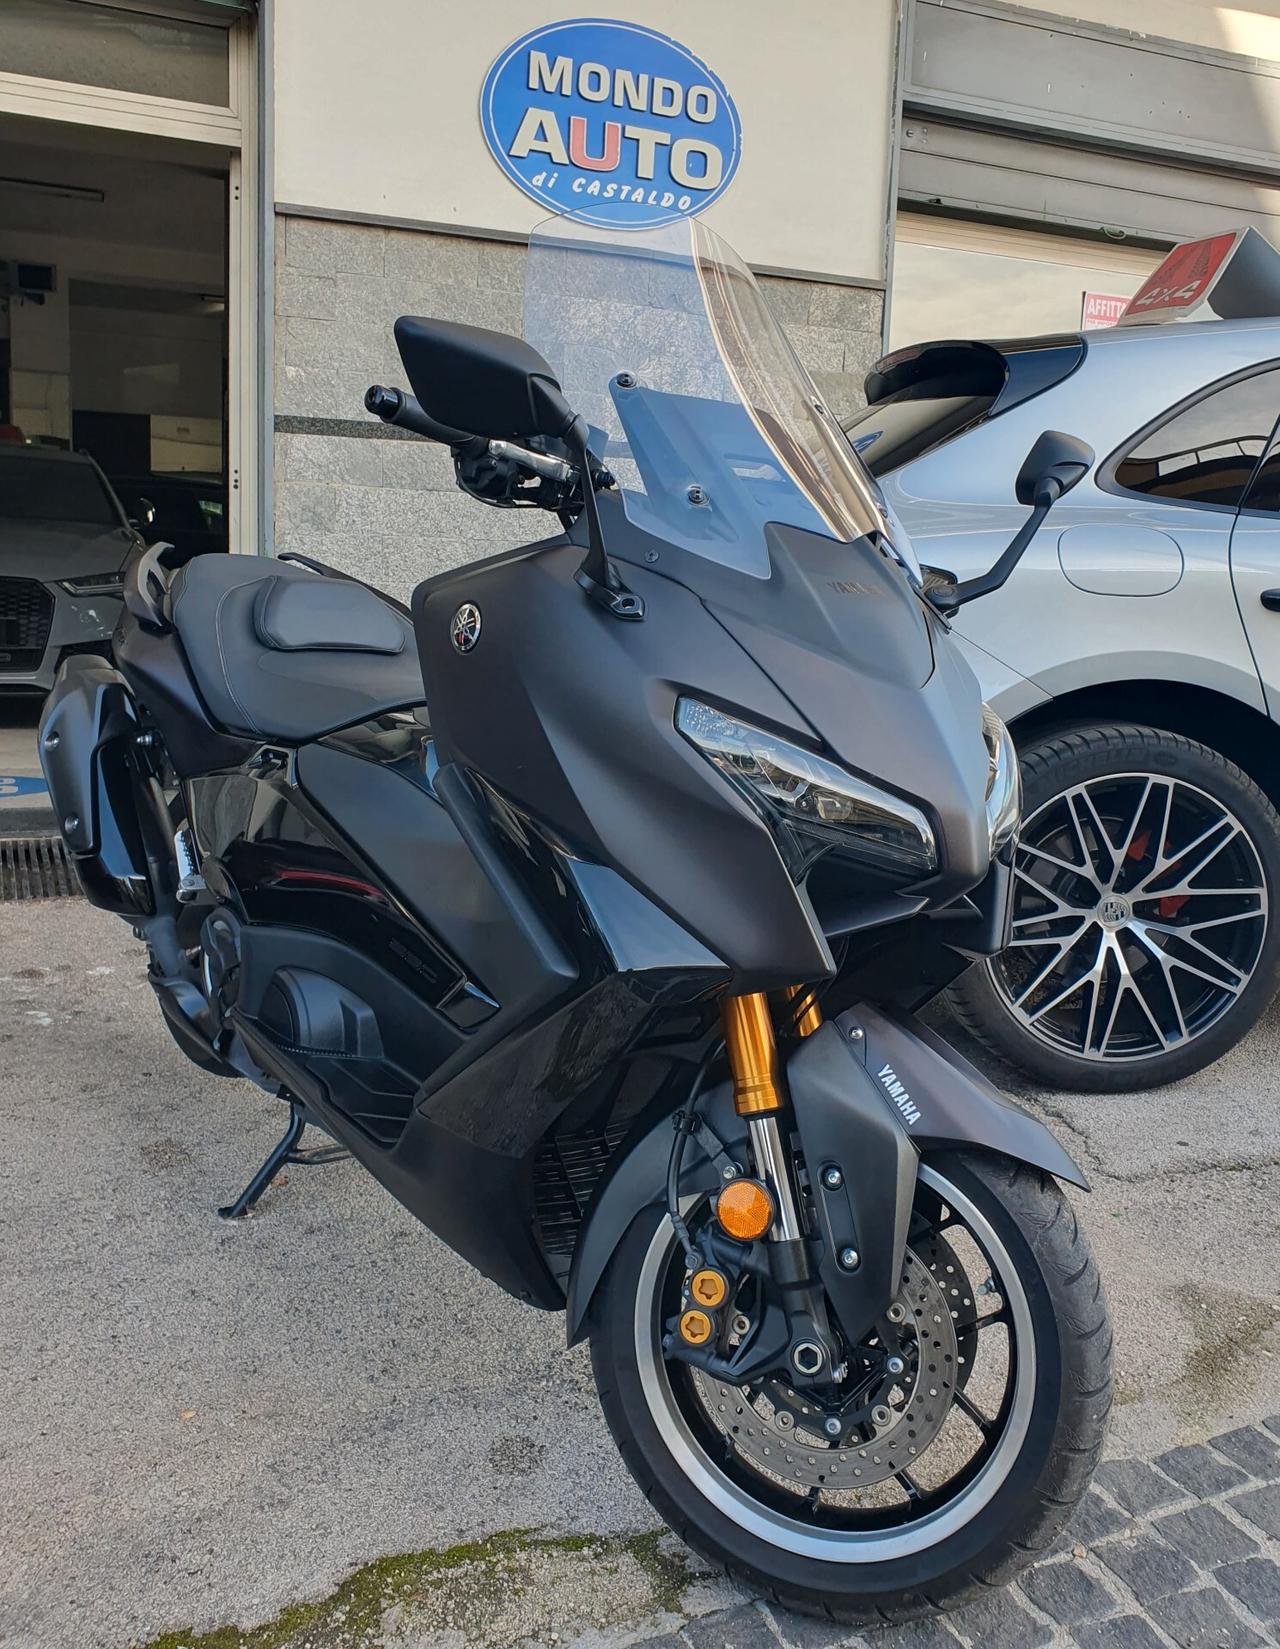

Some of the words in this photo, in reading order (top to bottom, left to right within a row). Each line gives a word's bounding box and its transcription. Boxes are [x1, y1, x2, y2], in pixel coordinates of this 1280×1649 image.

[528, 50, 717, 124] MONDO
[508, 107, 723, 190] AUTO
[531, 171, 559, 189] di
[572, 177, 692, 210] CASTALDO
[877, 1063, 922, 1126] YAMAHA
